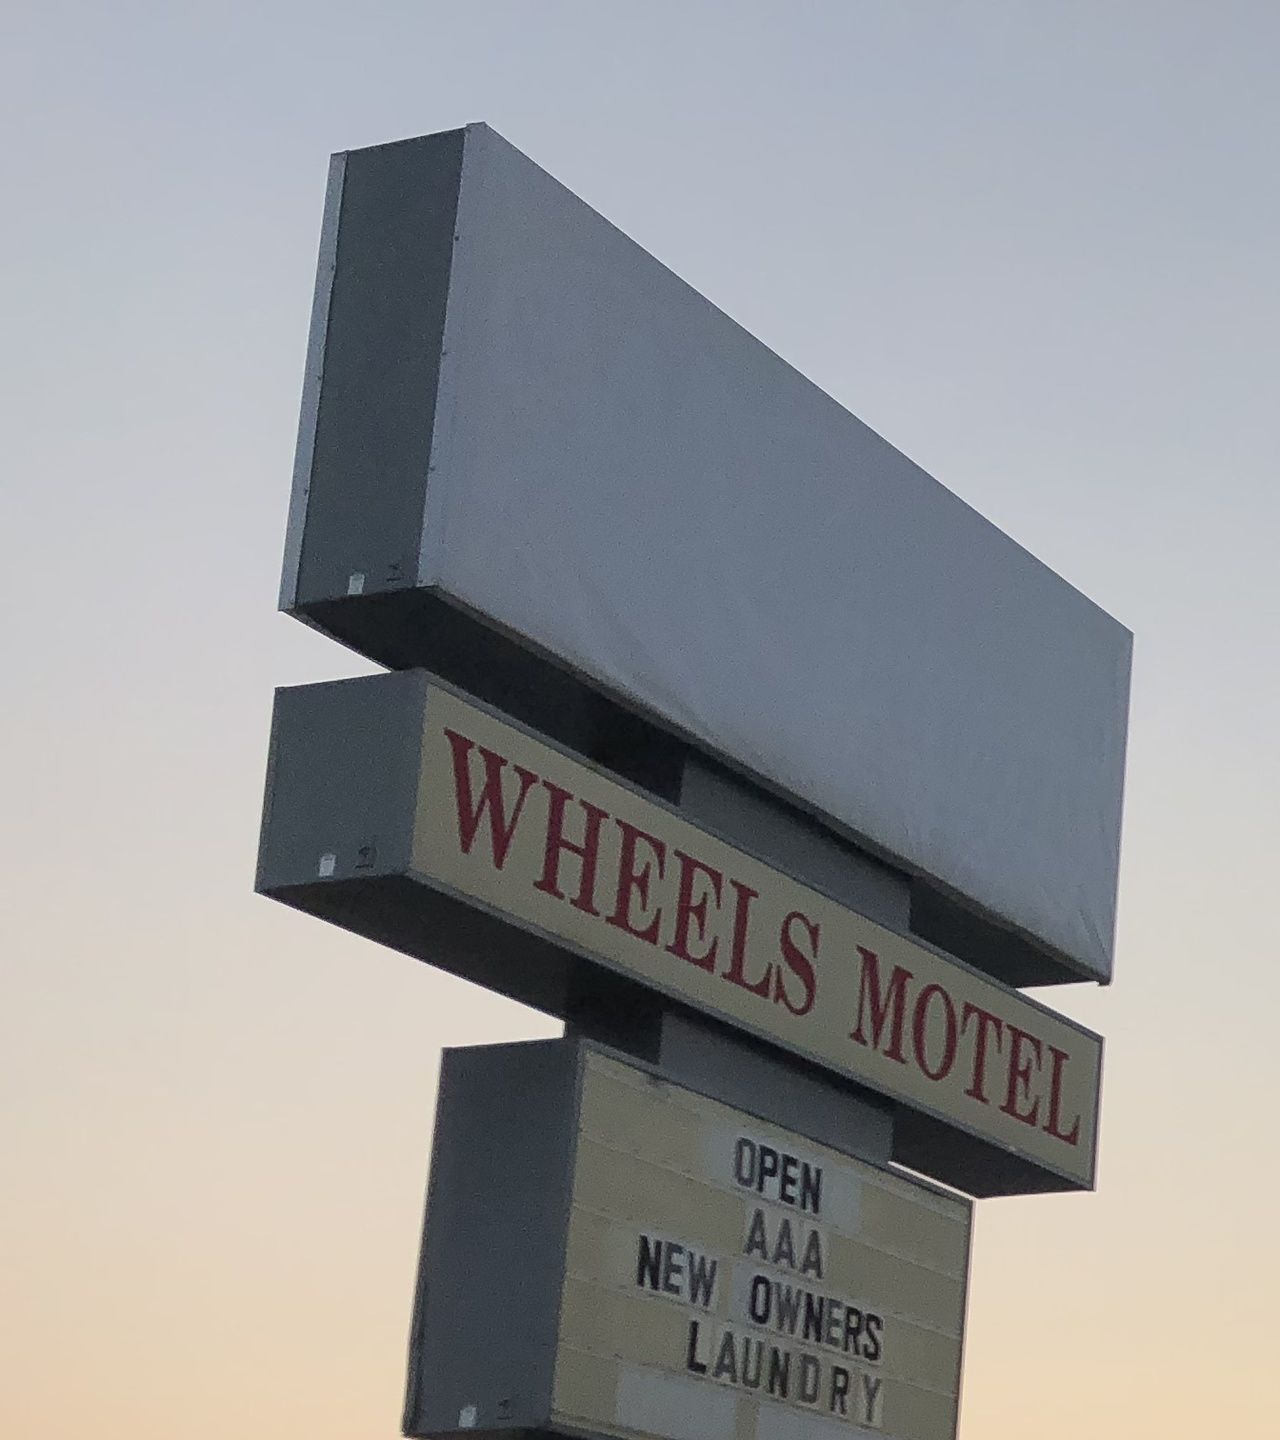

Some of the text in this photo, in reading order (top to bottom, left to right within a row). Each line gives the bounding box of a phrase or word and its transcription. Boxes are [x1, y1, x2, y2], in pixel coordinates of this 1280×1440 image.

[444, 727, 1081, 1146] WHEELS MOTEL
[735, 1138, 822, 1214] OPEN
[743, 1208, 824, 1280] AAA
[636, 1234, 884, 1362] NEW OWNERS
[687, 1320, 882, 1424] LAUNDRY
